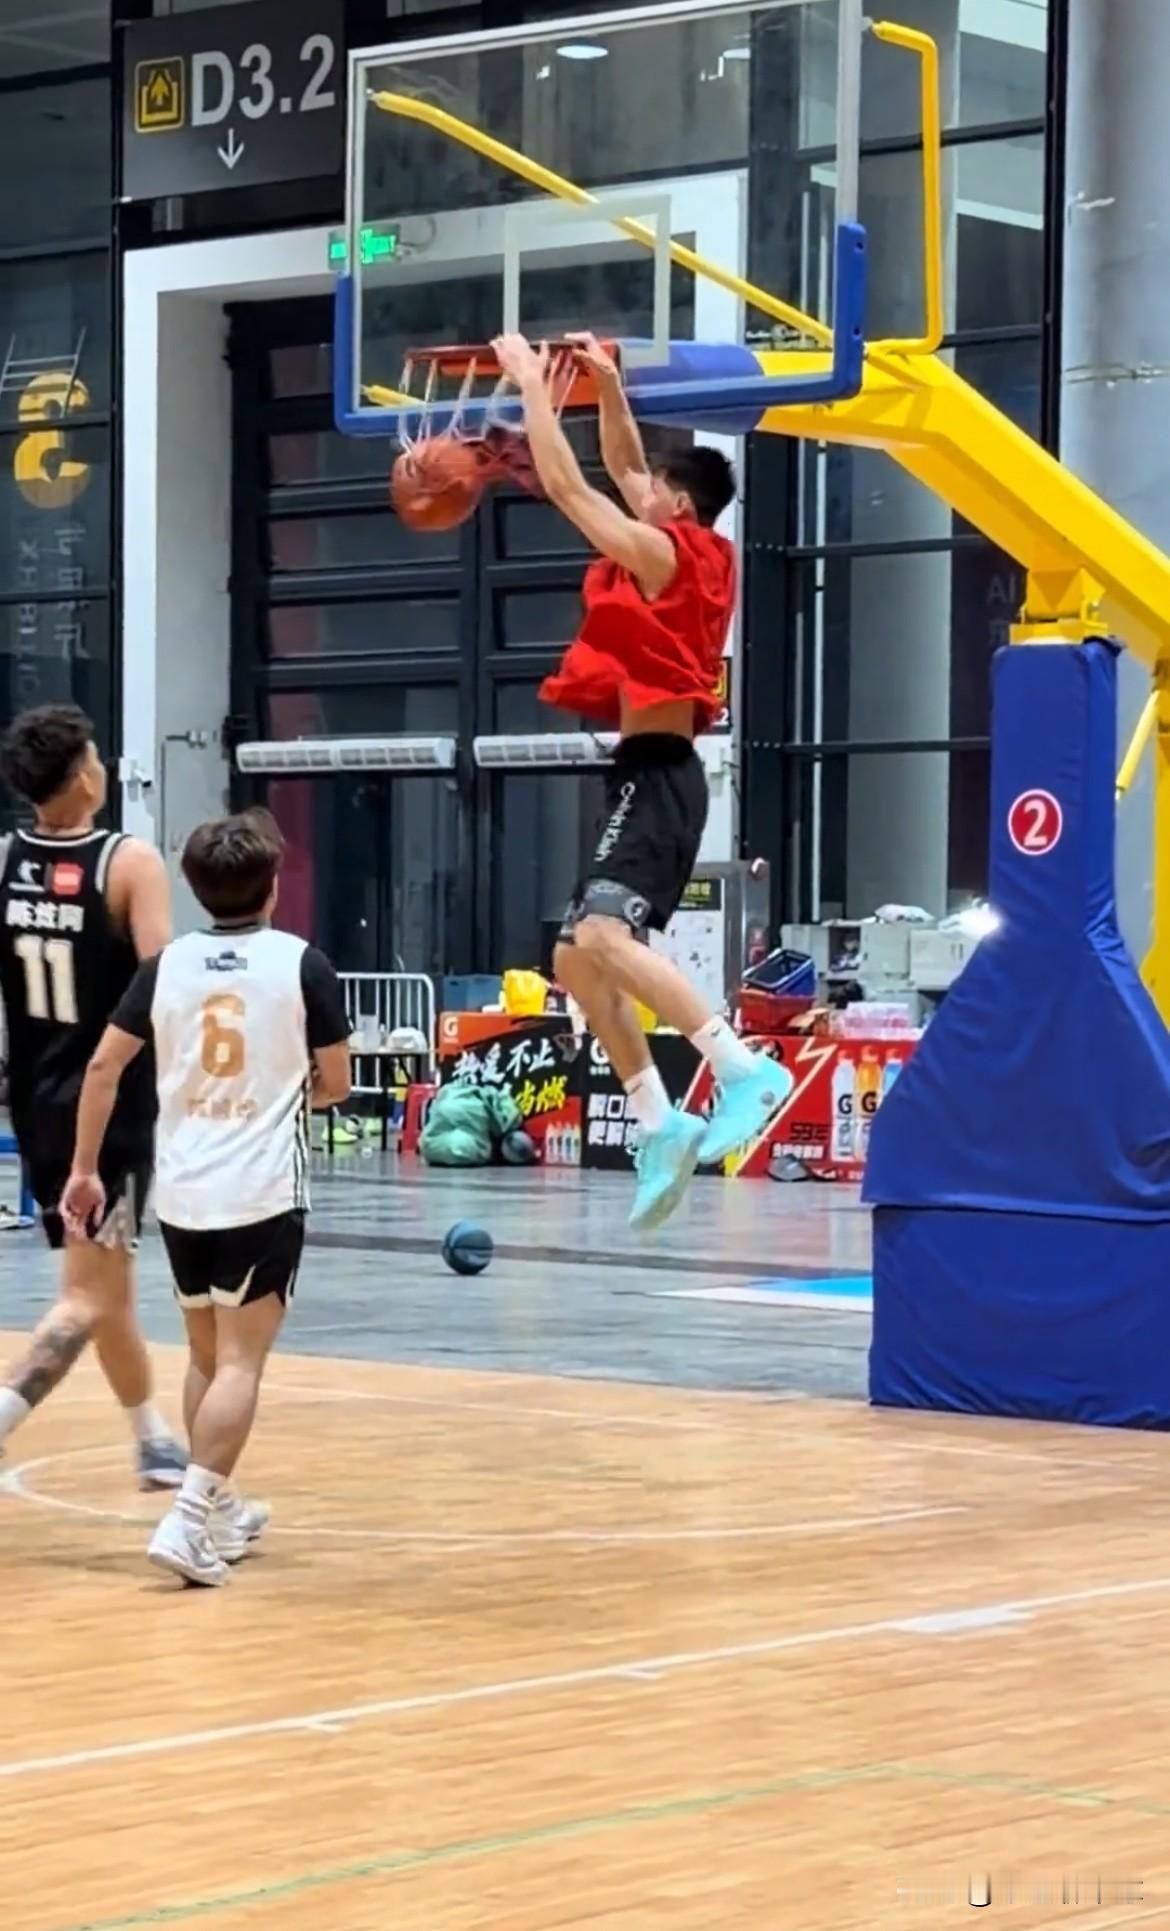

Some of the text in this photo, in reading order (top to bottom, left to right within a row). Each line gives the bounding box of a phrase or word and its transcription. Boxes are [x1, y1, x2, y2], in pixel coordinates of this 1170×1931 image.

[190, 33, 337, 128] D3.2
[1023, 799, 1049, 848] 2
[13, 934, 80, 1024] 11
[201, 992, 247, 1078] 6
[443, 1016, 459, 1037] G
[838, 1090, 877, 1115] G G
